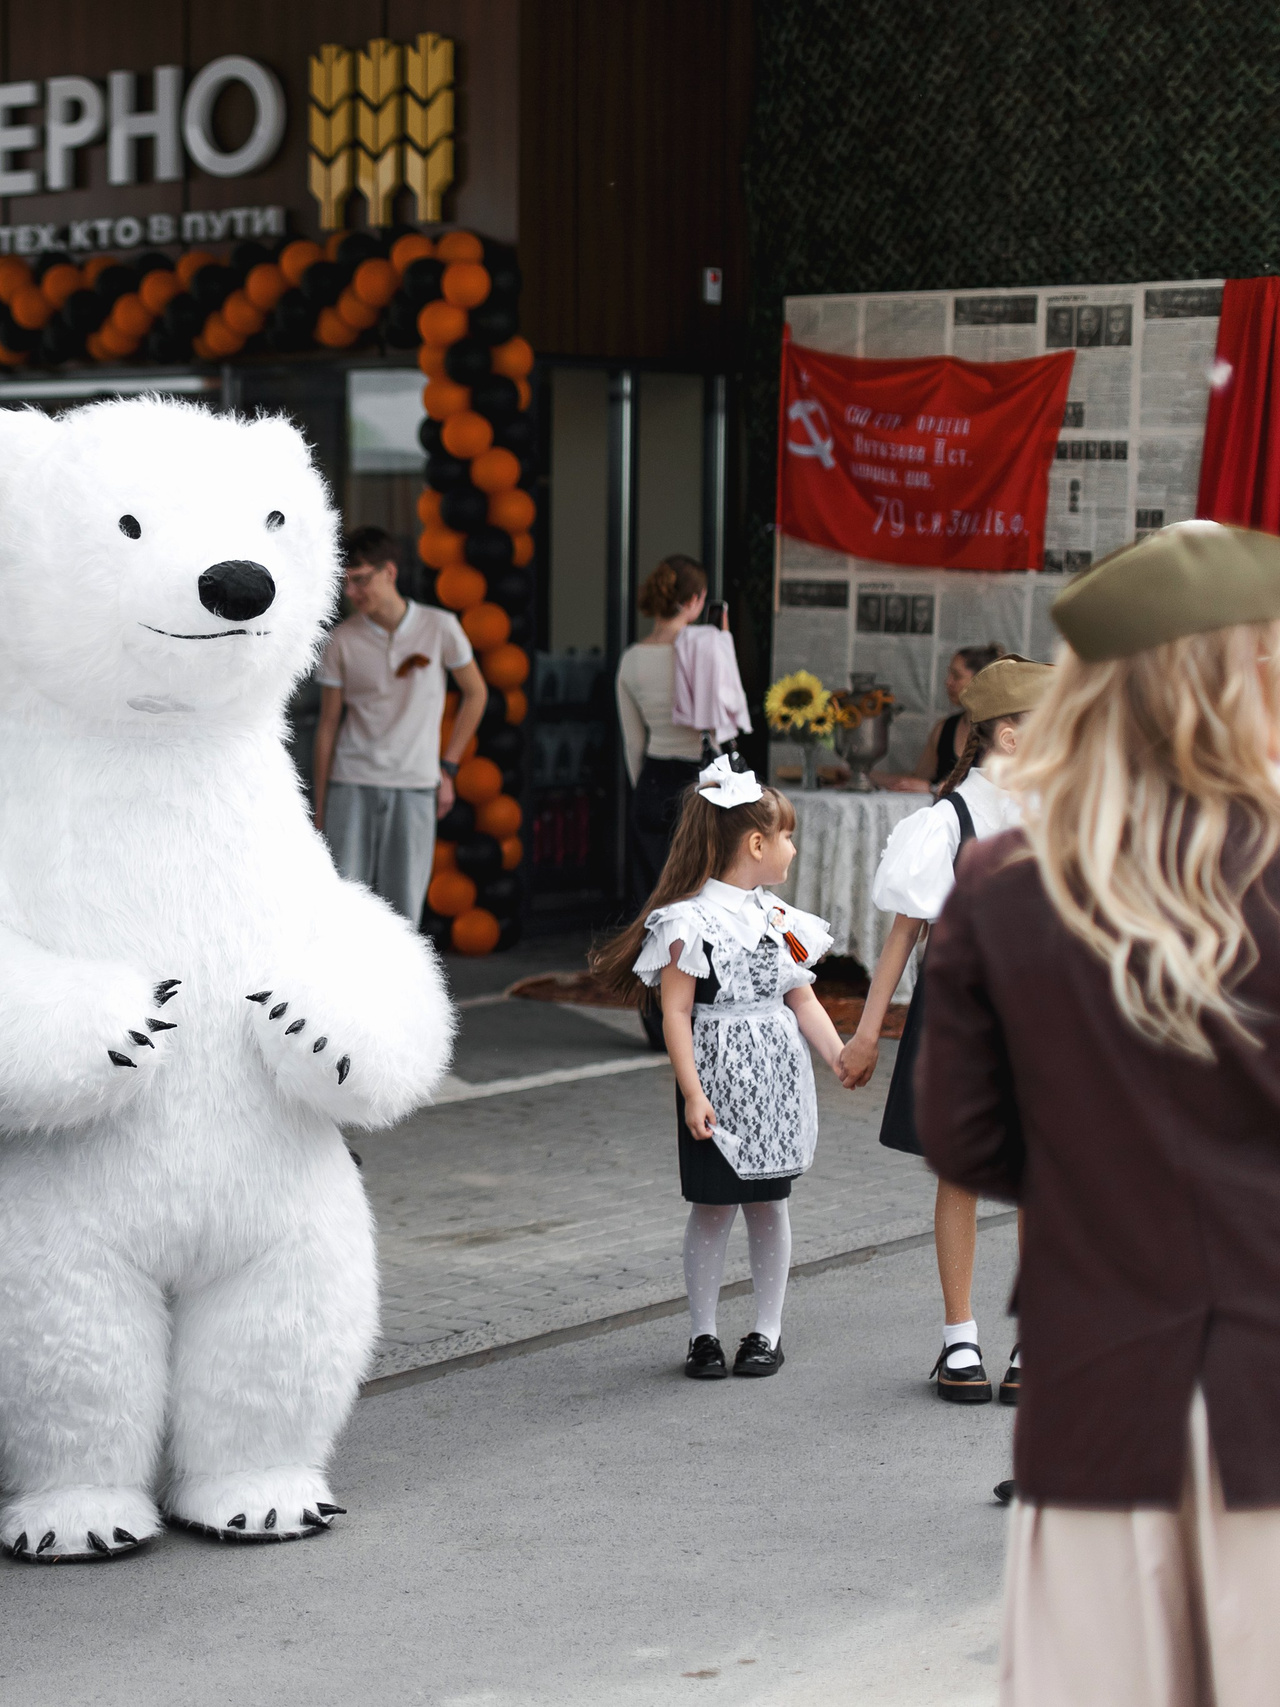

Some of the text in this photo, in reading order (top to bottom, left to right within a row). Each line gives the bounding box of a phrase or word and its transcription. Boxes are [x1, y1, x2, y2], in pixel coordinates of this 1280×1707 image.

[70, 216, 142, 249] КТО
[147, 212, 174, 245] В
[181, 205, 286, 243] ПУТИ
[872, 496, 906, 538] 79
